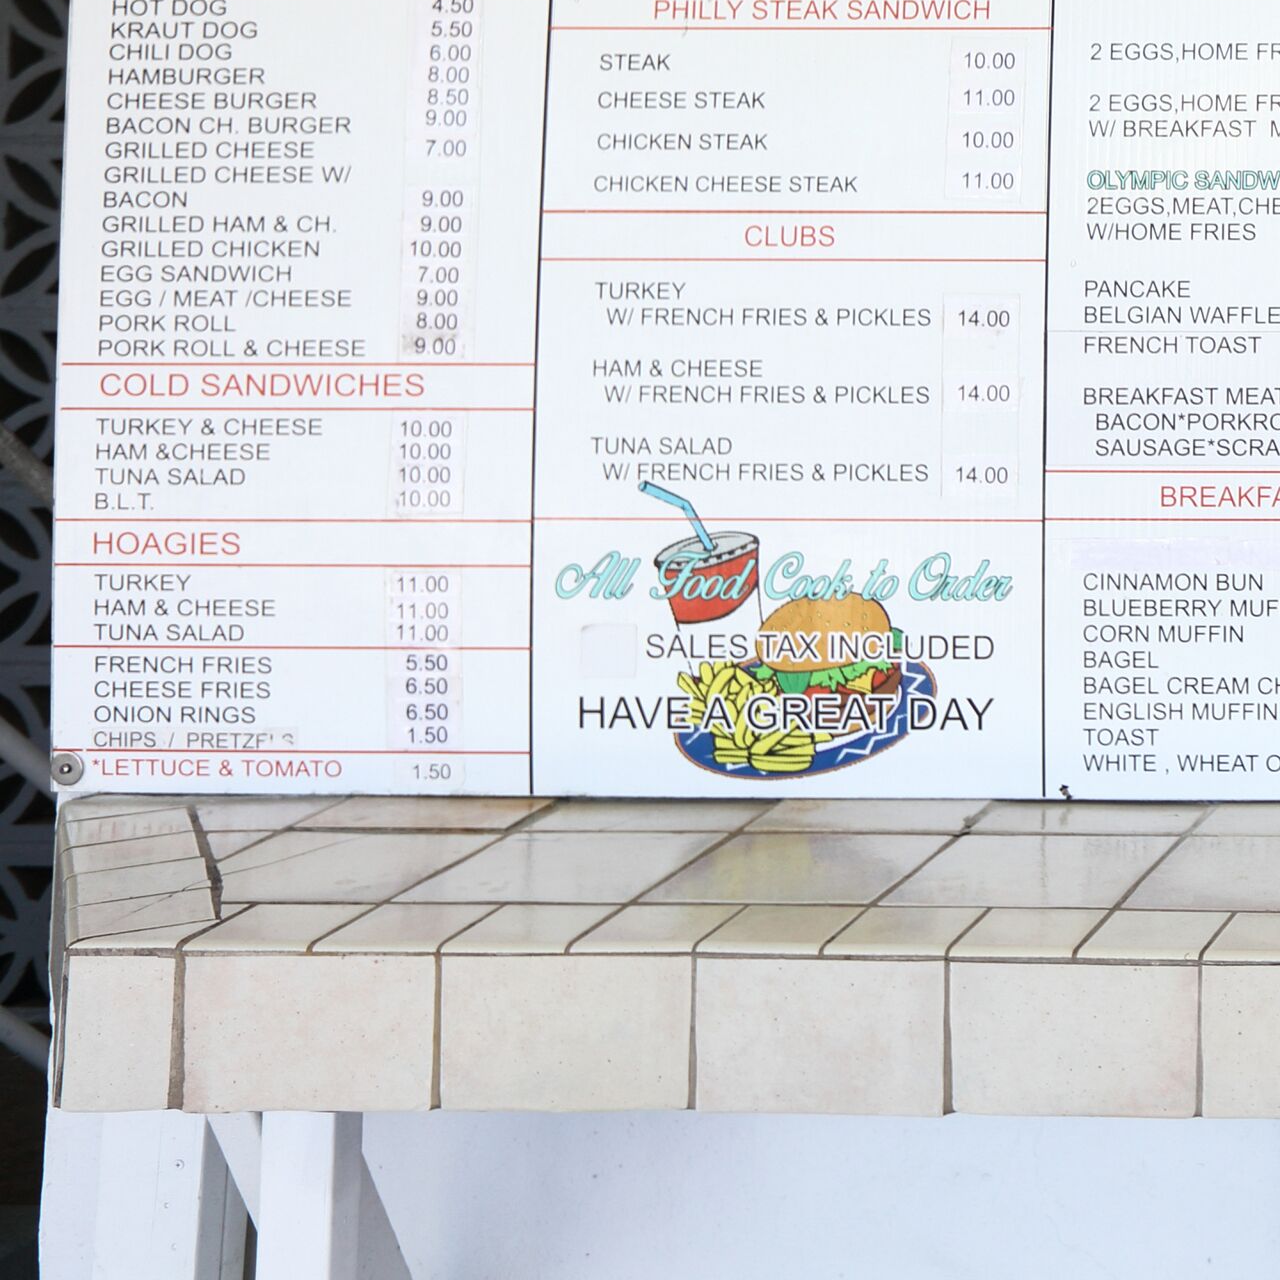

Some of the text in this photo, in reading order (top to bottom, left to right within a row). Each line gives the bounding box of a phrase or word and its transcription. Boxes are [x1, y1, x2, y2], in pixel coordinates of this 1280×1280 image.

[653, 0, 991, 21] PHILLY STEAK SANDWICH
[599, 51, 1016, 72] STEAK 10.00
[1090, 42, 1102, 61] 2
[1109, 42, 1249, 63] EGGS,HOME
[108, 65, 470, 86] HAMBURGER 8.00
[593, 171, 1014, 193] CHICKEN CHEESE STEAK 11.00
[1086, 169, 1189, 191] OLYMPIC
[744, 224, 835, 248] CLUBS
[101, 239, 462, 259] GRILLED CHICKEN 10.00
[594, 281, 686, 300] TURKEY
[98, 312, 458, 333] PORK ROLL 8.00
[606, 307, 1010, 328] W/ FRENCH FRIES & PICKLES 14.00
[1084, 305, 1182, 325] BELGIAN
[99, 372, 425, 397] COLD SANDWICHES
[95, 417, 453, 438] TURKEY & CHEESE 10.00
[94, 489, 451, 511] B.L.T. 10.00
[93, 531, 241, 556] HOAGIES
[555, 550, 1013, 602] All Food Cook to Order
[1083, 598, 1223, 617] BLUEBERRY
[645, 633, 995, 661] SALES TAX INCLUDED
[1083, 650, 1160, 669] BAGEL
[93, 703, 449, 724] ONION RINGS 6.50
[578, 696, 995, 731] HAVE A GREAT DAY
[1082, 727, 1160, 747] TOAST
[218, 759, 234, 777] &
[241, 759, 343, 778] TOMATO
[412, 762, 452, 780] 1.50
